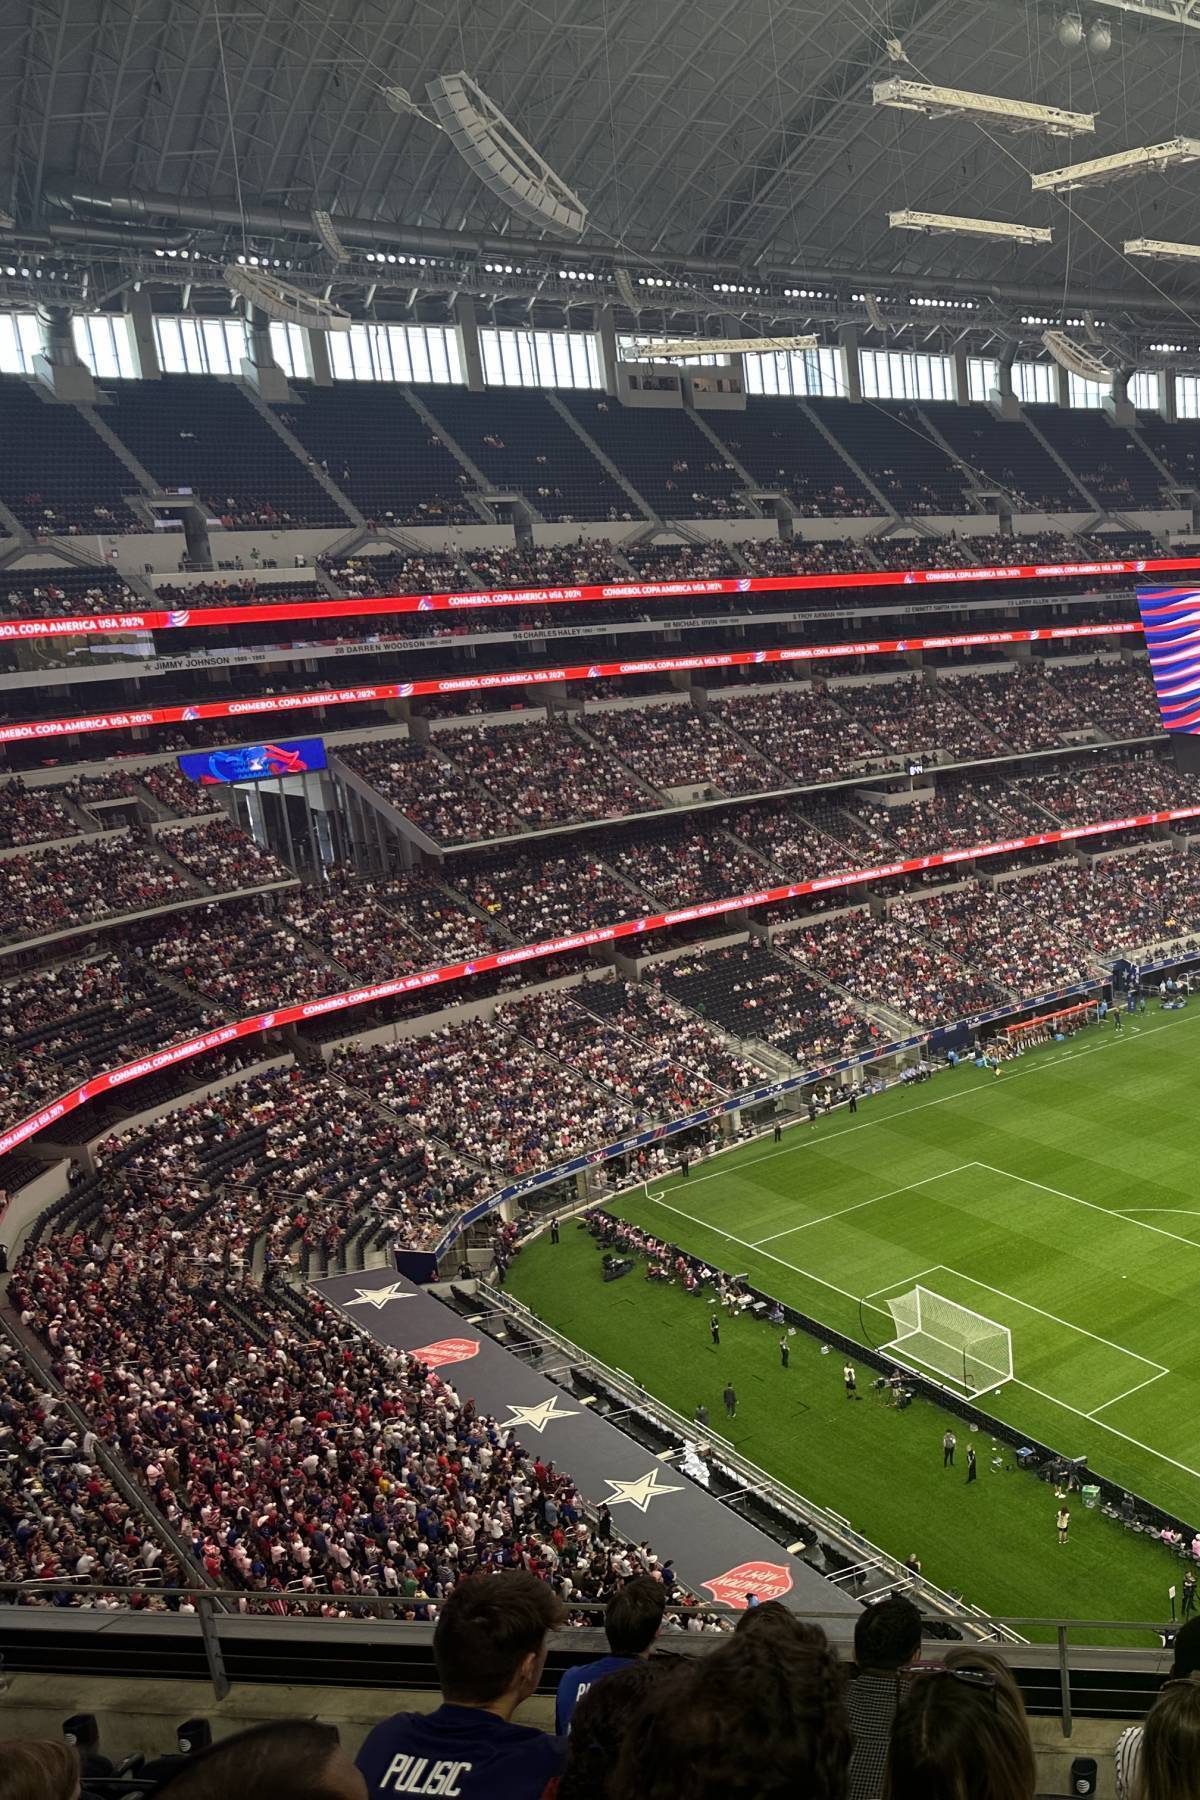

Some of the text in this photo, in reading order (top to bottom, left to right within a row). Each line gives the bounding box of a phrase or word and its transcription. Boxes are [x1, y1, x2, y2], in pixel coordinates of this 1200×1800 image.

[449, 589, 581, 606] CONMEBOL COPA AMERICA USA 2024
[602, 582, 722, 597] CONMEBOL COPA AMERICA USA 2024
[22, 616, 144, 634] COPA AMERICA USA 2024
[672, 620, 702, 628] MICHAEL
[522, 630, 557, 640] CHARLES
[558, 628, 582, 636] HALEY
[346, 644, 382, 654] DARREN
[384, 640, 426, 650] WOODSON
[154, 661, 183, 671] JIMMY
[185, 656, 230, 668] JOHNSON
[439, 670, 565, 690] CONMEBOL COPA AMERICA USA 2024
[229, 689, 376, 713] CONMEBOL COPA AMERICA USA 2024
[36, 723, 63, 735] COPA
[65, 718, 108, 731] AMERICA
[111, 716, 129, 726] USA
[131, 713, 153, 723] 2024
[303, 972, 439, 1017] CONMEBOL COPA AMERICA USA 2024
[109, 1028, 235, 1084] CONMEBOL COPA AMERICA USA 2024
[380, 1753, 472, 1798] PULISIC
